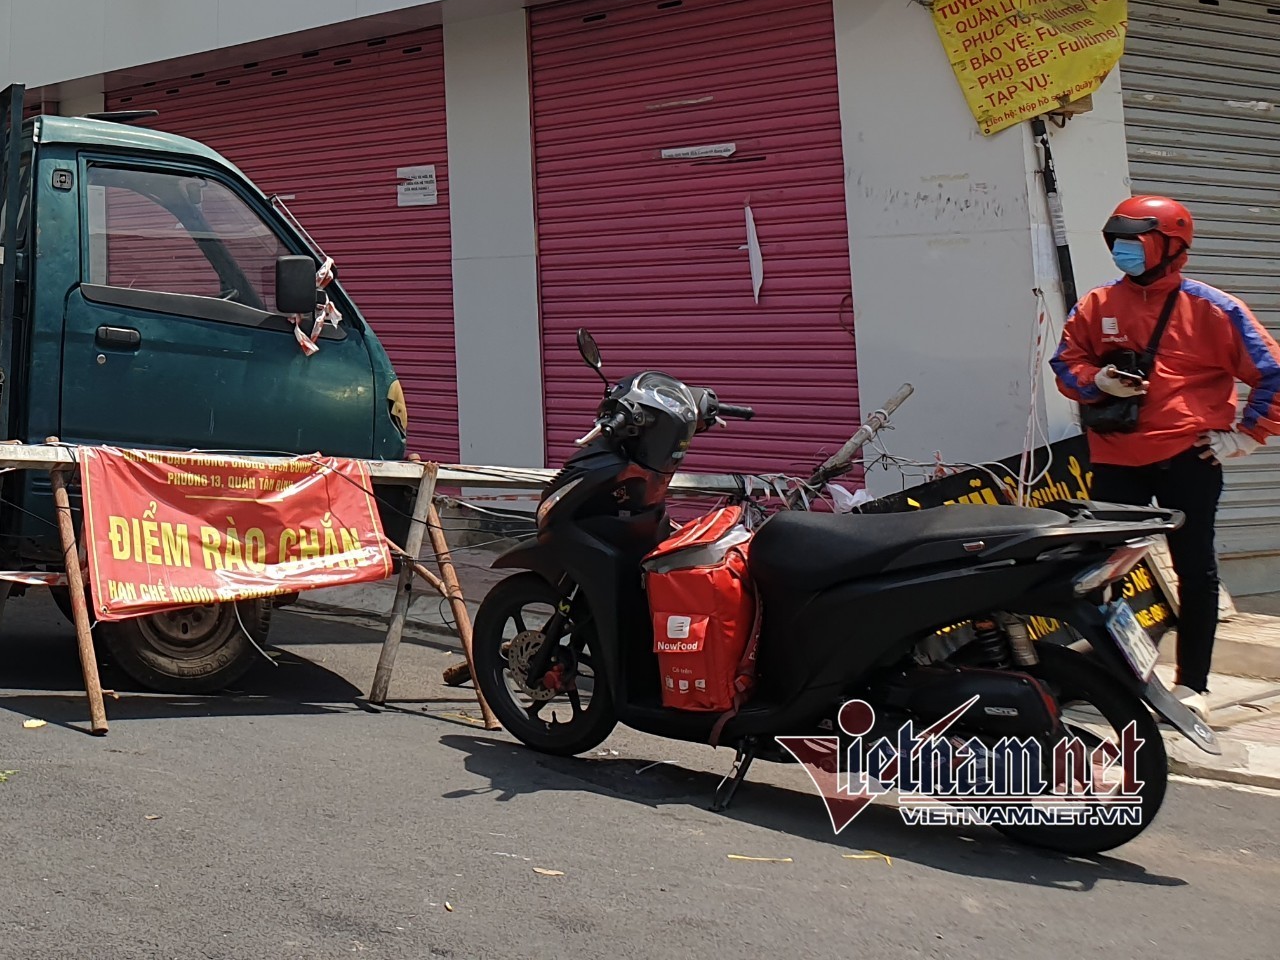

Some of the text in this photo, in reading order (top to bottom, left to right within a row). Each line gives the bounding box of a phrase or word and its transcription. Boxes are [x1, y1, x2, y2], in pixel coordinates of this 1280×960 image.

[955, 4, 1000, 34] QUẢN
[962, 23, 1005, 53] PHỤC
[969, 46, 1003, 72] BẢO
[976, 63, 1014, 90] PHỤ
[1015, 48, 1058, 73] BẾP:
[227, 475, 257, 490] QUẬN
[107, 500, 365, 573] ĐIỂM RÀO CHẮN
[140, 578, 170, 603] CHẾ
[657, 641, 699, 651] NowFood
